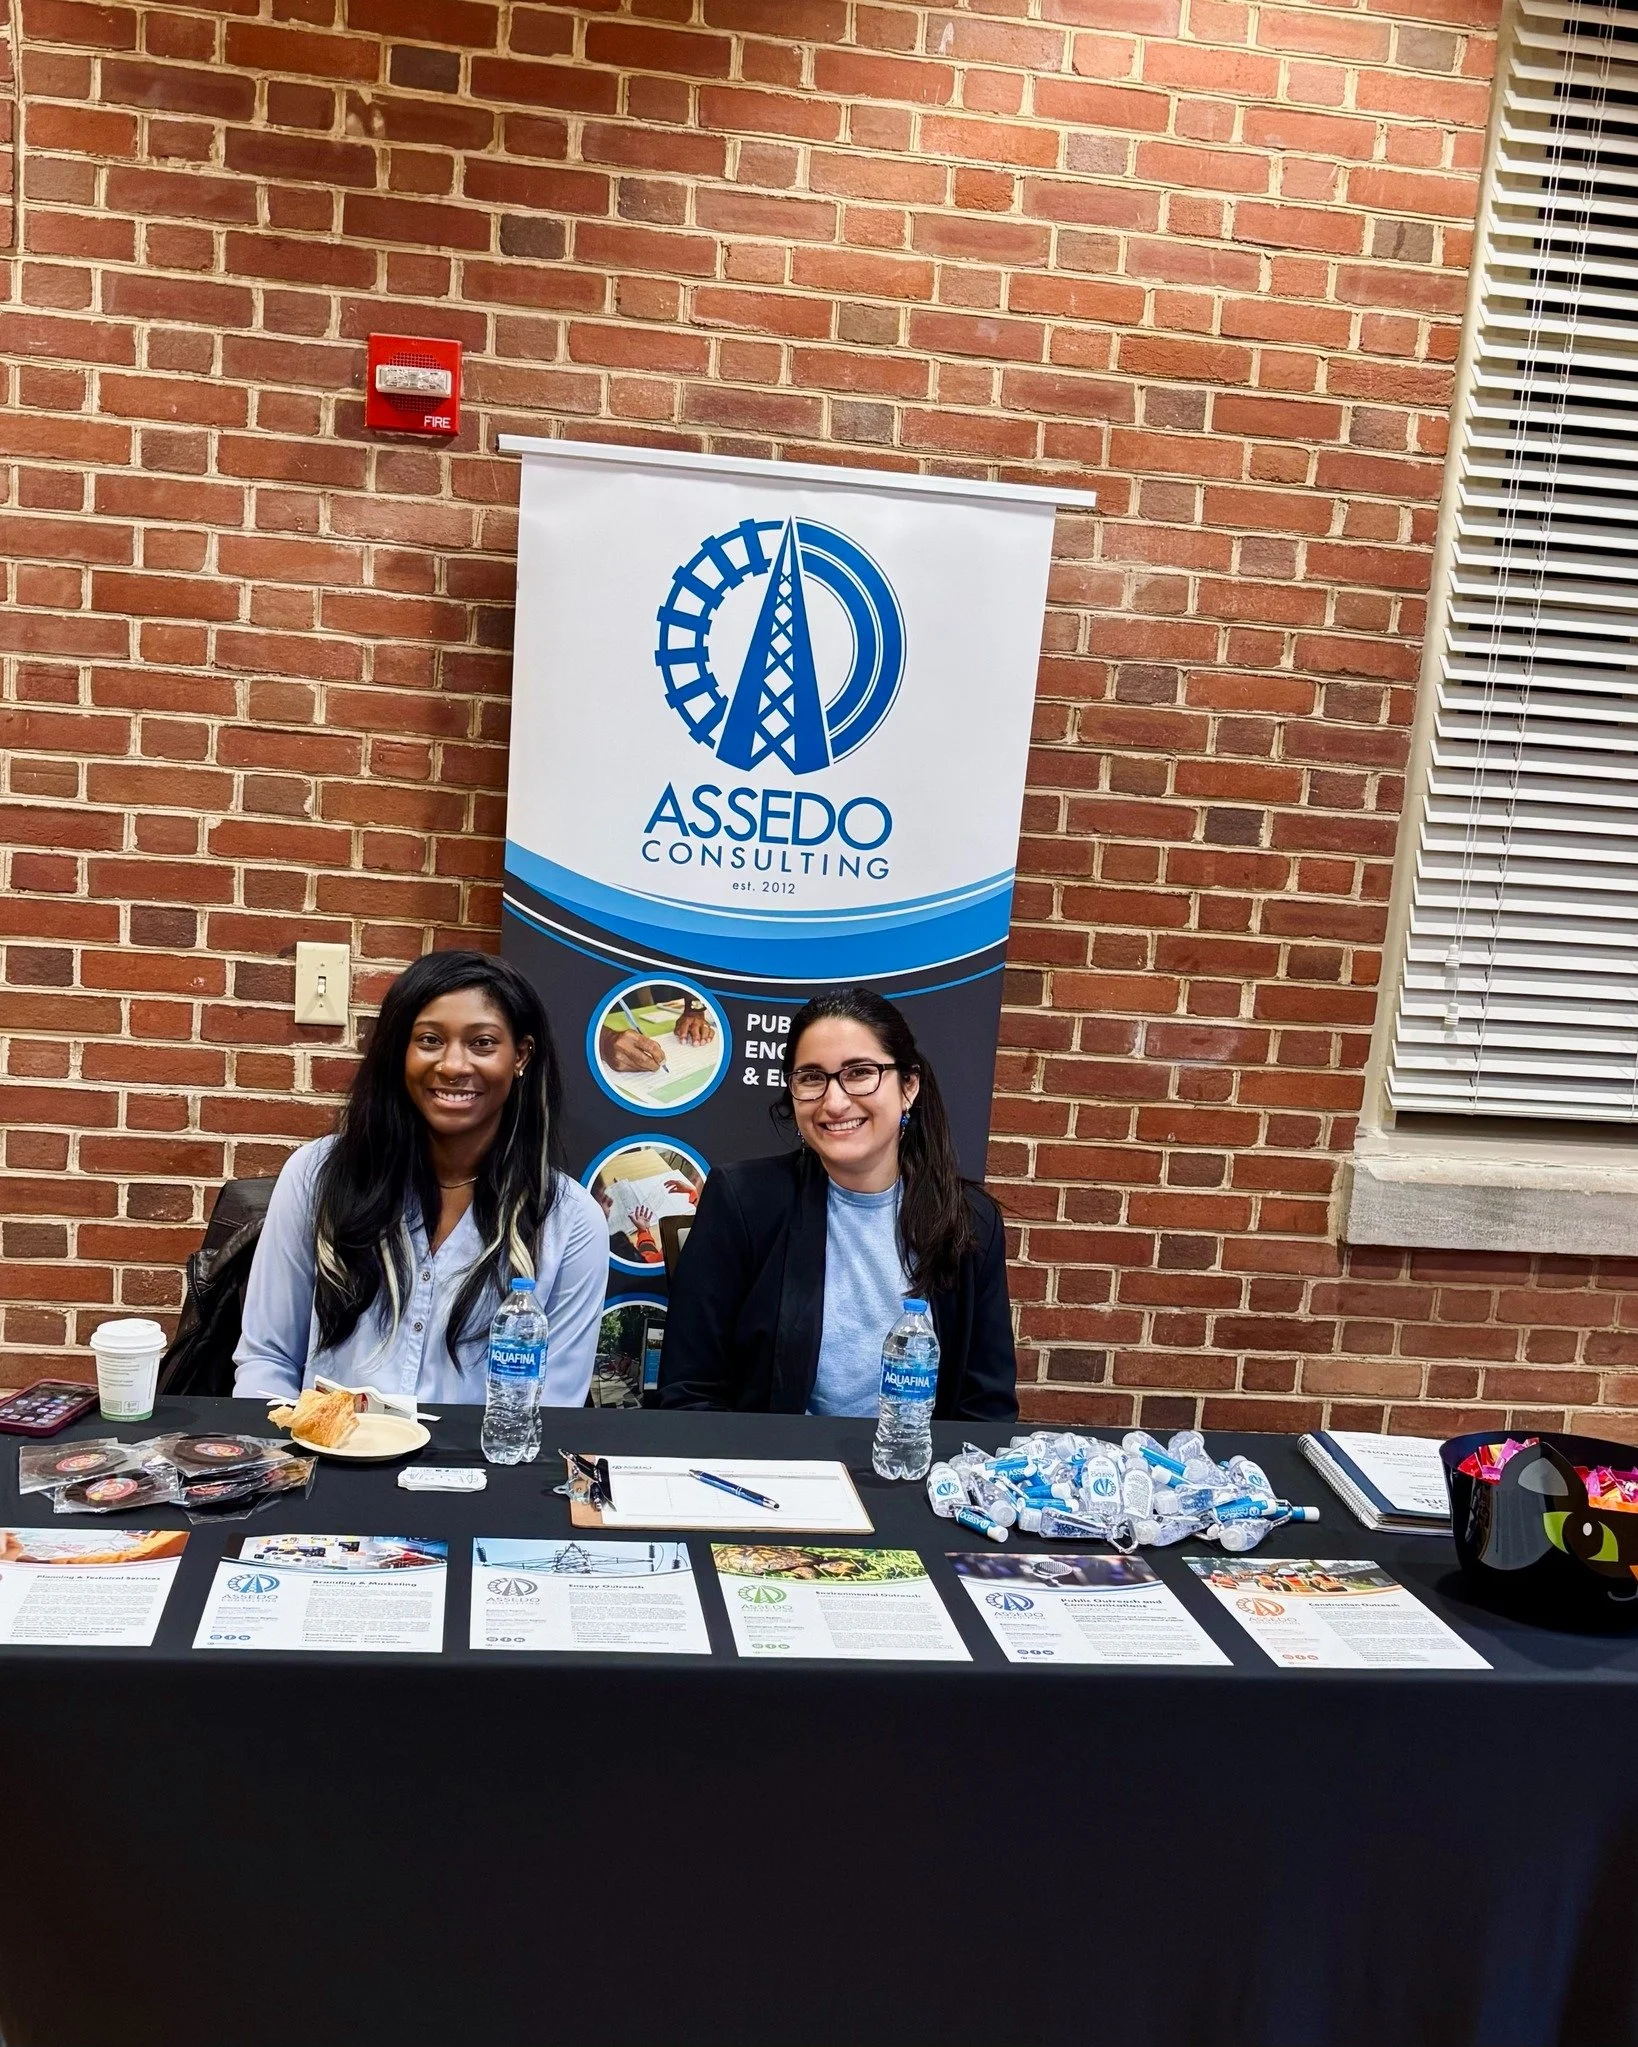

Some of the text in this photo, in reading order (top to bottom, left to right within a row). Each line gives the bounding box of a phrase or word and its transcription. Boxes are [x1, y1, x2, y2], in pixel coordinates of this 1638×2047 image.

[424, 415, 451, 429] FIRE
[643, 781, 893, 851] ASSEDO
[641, 839, 889, 880] CONSULTING
[732, 881, 796, 895] est. 2012
[742, 1066, 760, 1086] &
[491, 1349, 536, 1365] AQUAFINA
[884, 1371, 931, 1388] AQUAFINA
[959, 1511, 982, 1527] ASSEDO
[313, 1579, 357, 1587] Branding
